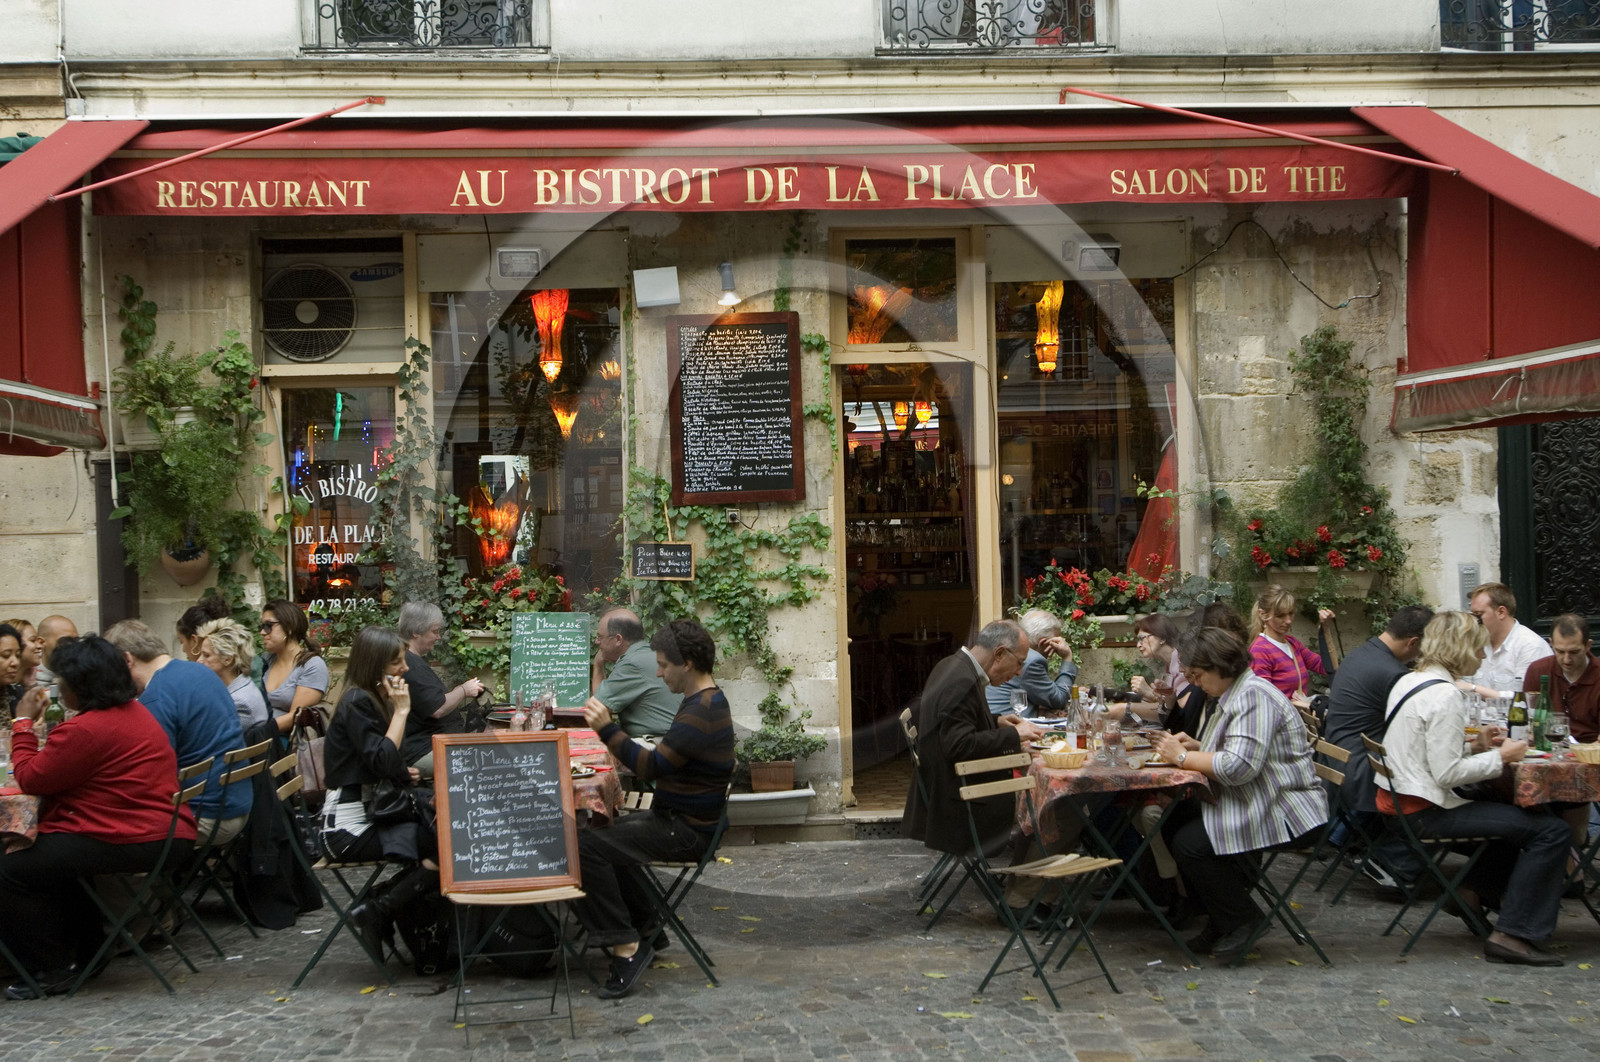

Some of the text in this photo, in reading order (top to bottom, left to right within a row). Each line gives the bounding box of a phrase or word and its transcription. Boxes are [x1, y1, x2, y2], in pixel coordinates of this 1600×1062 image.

[451, 163, 1038, 206] AU BISTROT DE LA PLACE
[1110, 166, 1346, 195] SALON DE THE
[156, 180, 371, 208] RESTAURANT
[317, 477, 379, 504] BISTRO
[294, 526, 313, 544] DE
[319, 525, 338, 544] LA
[308, 552, 371, 564] RESTAURA
[536, 617, 558, 630] Menu
[480, 749, 512, 767] Menu
[476, 771, 503, 782] Soupe
[477, 780, 502, 791] Avocat
[477, 792, 495, 802] Pâté
[480, 861, 504, 873] Glace
